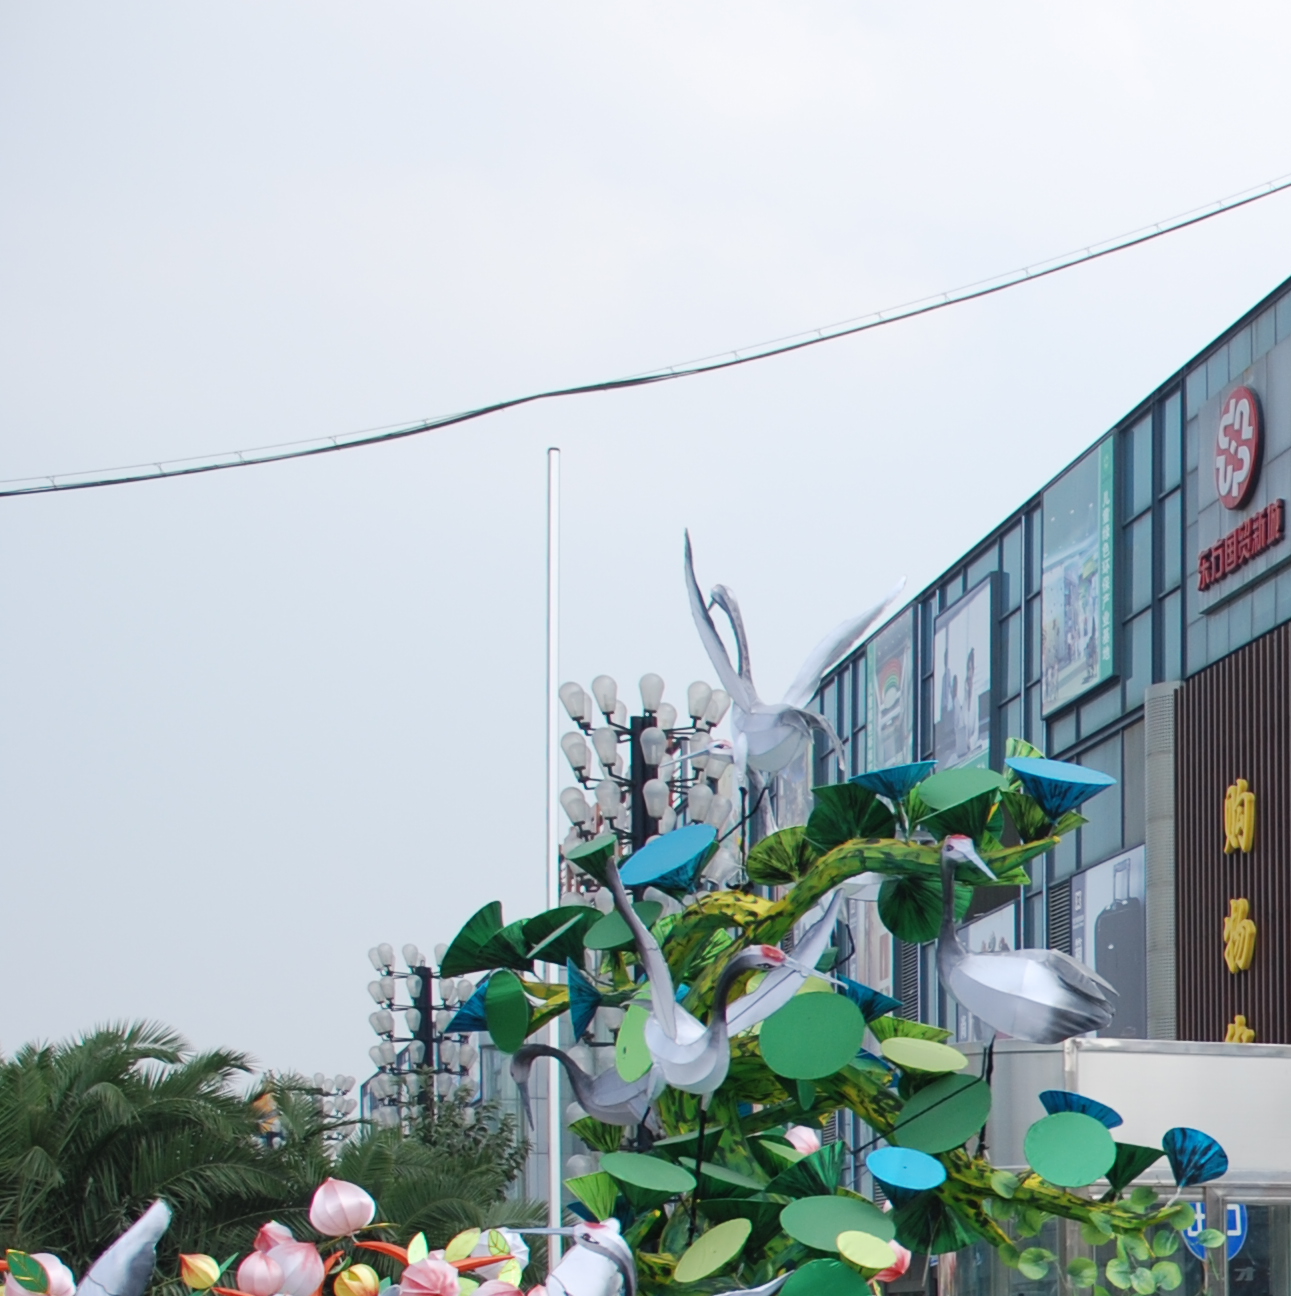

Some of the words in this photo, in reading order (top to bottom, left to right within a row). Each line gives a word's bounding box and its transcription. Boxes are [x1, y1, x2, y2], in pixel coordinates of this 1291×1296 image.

[1197, 498, 1286, 592] 东方国贸新城
